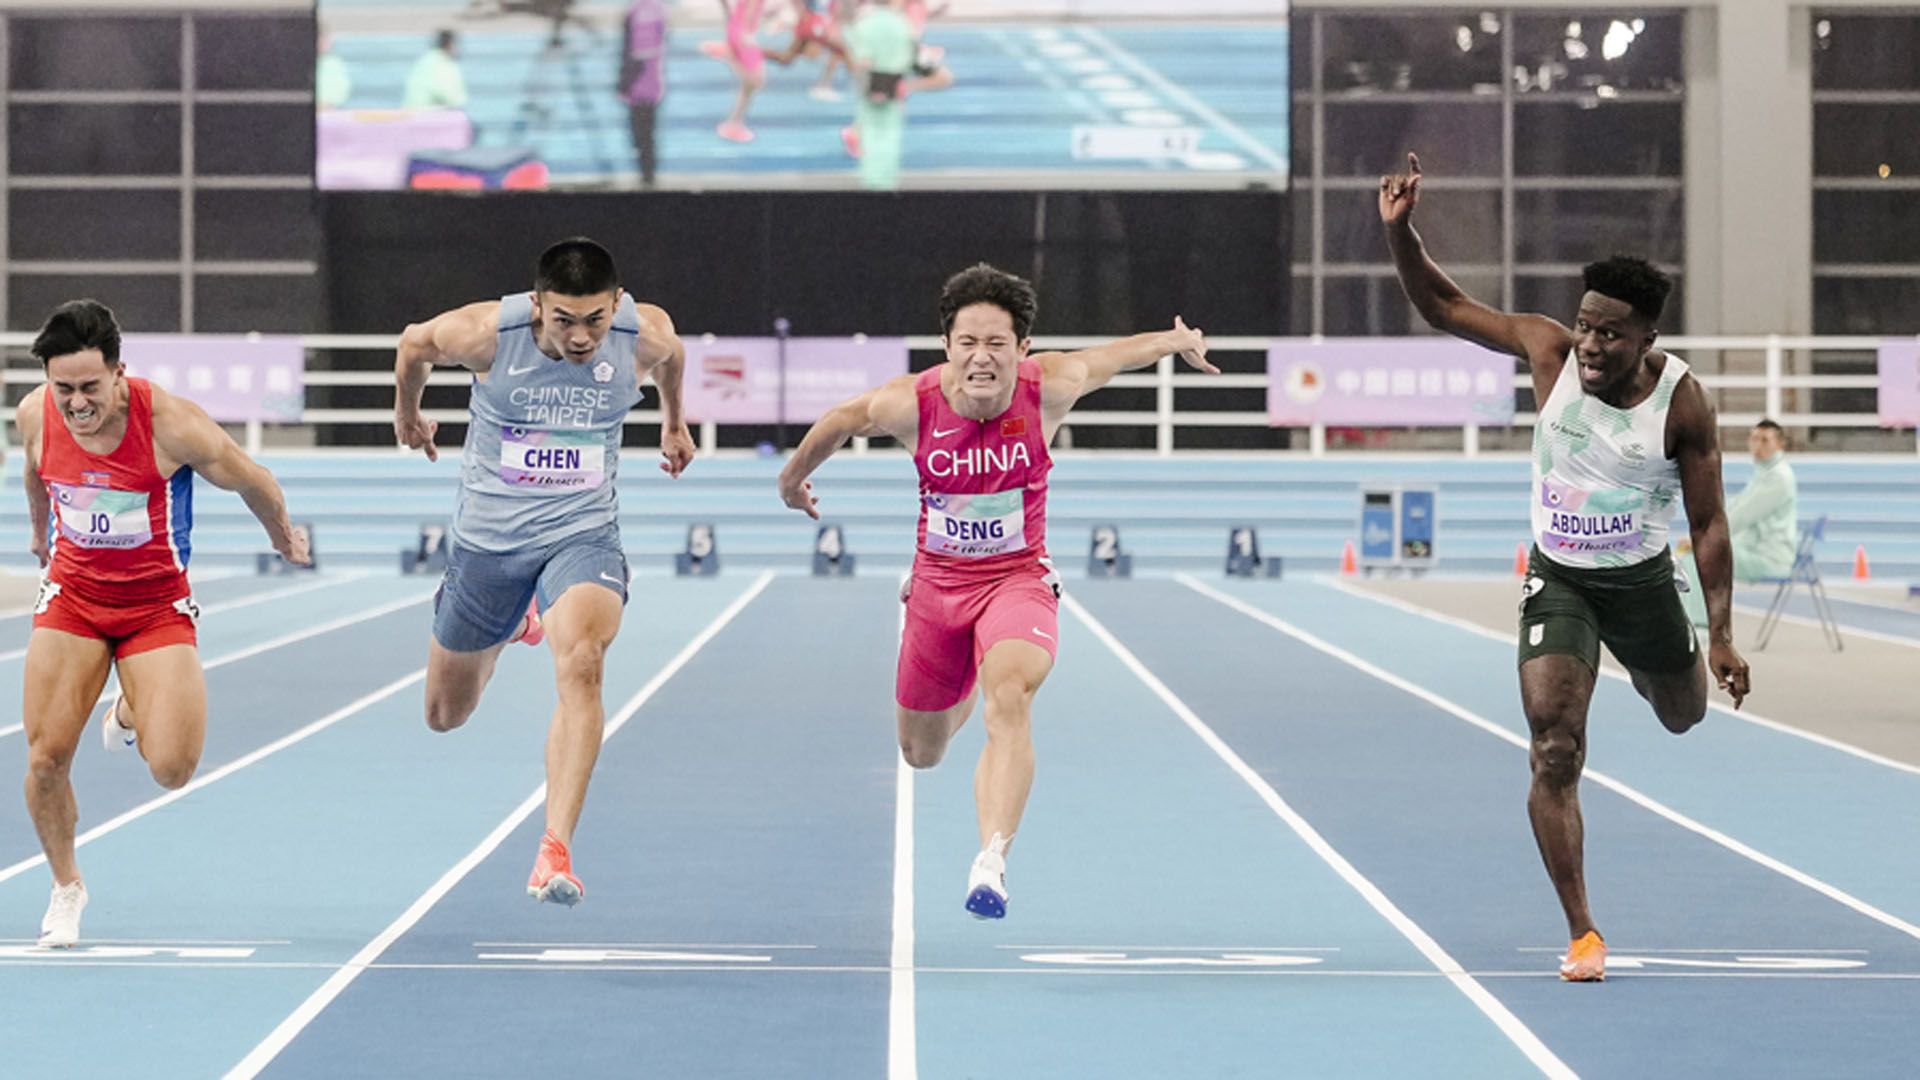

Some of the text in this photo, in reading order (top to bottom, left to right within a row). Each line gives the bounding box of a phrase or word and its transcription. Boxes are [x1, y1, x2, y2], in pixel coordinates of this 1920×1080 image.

[510, 387, 612, 410] CHINESE
[523, 405, 595, 428] TAIPEI
[523, 448, 581, 470] CHEN
[927, 442, 1031, 476] CHINA
[89, 512, 110, 534] JO
[945, 517, 1004, 541] DENG
[1550, 513, 1633, 536] ABDULLAH
[1095, 527, 1117, 560] 2
[1235, 528, 1251, 557] 1
